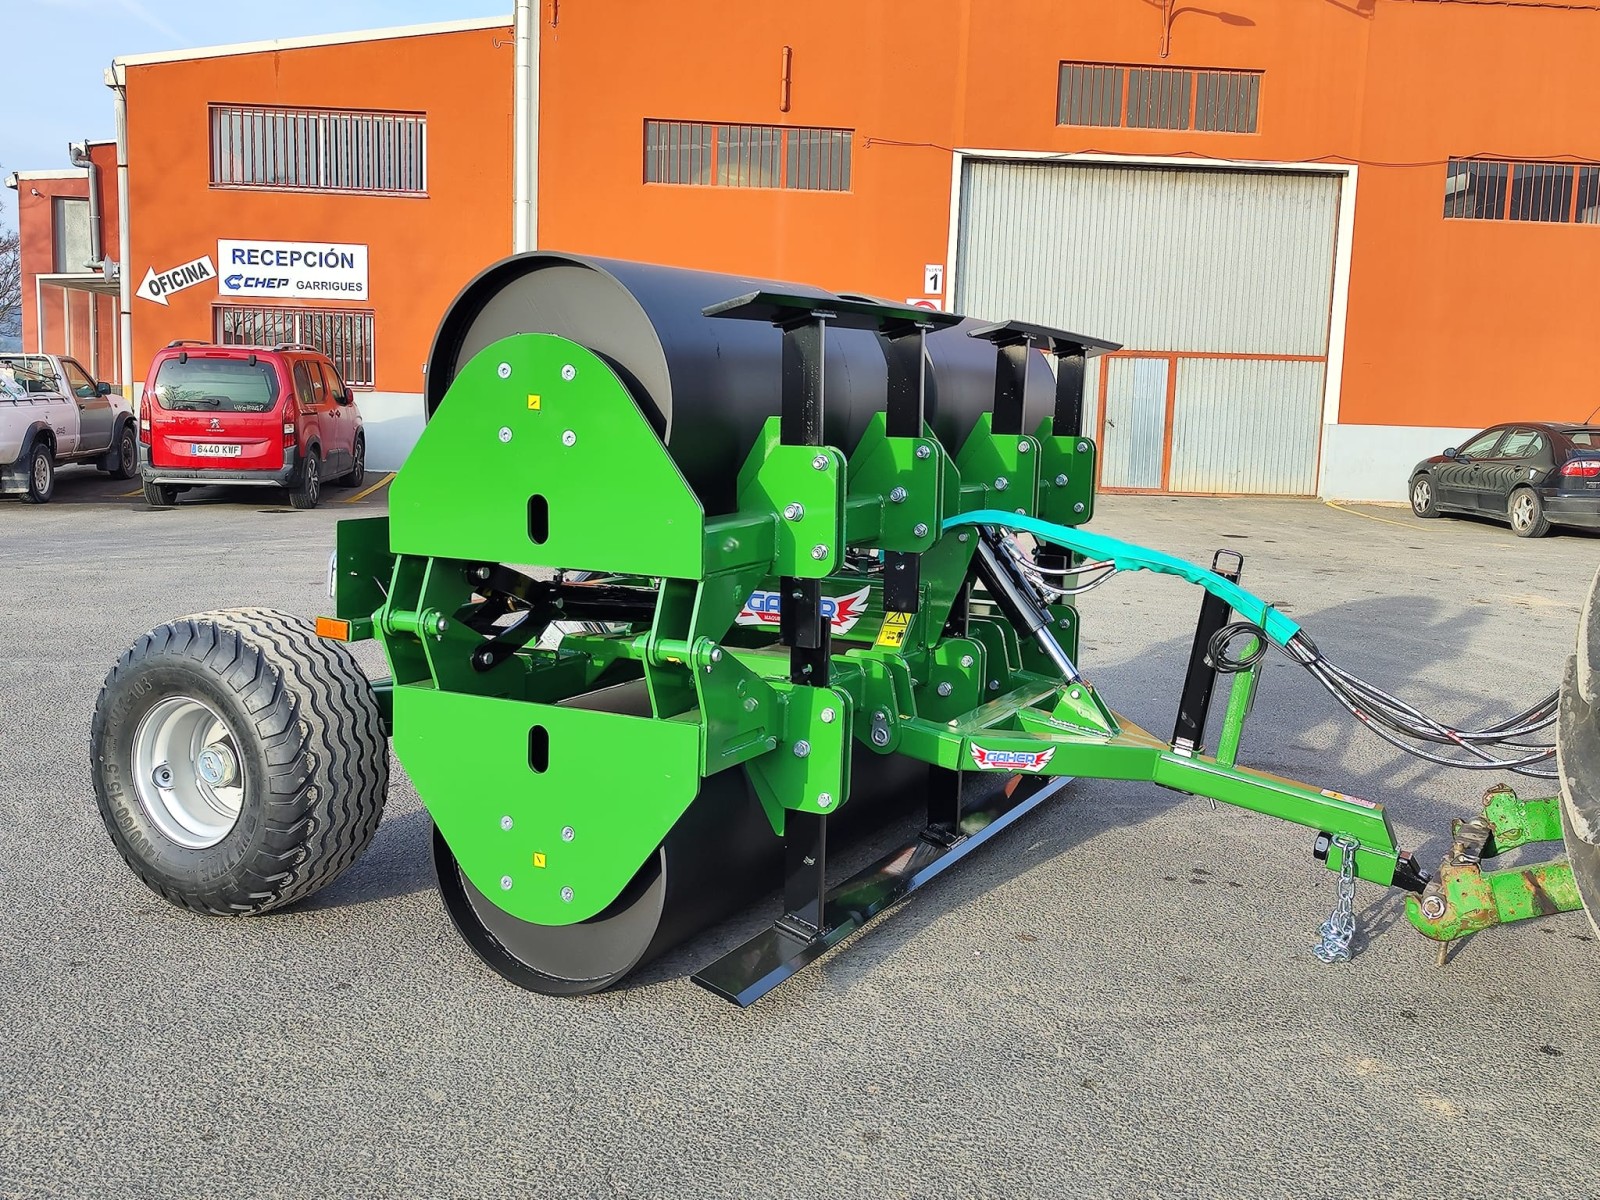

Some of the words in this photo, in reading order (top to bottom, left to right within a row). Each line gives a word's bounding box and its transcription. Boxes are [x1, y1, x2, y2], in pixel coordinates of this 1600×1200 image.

[232, 248, 354, 269] RECEPCIÓN
[148, 261, 210, 297] OFICINA
[243, 277, 290, 289] CHEP
[296, 280, 363, 292] GARRIGUES
[930, 273, 938, 291] 1
[747, 593, 836, 618] GAR
[986, 752, 1036, 764] GAHER
